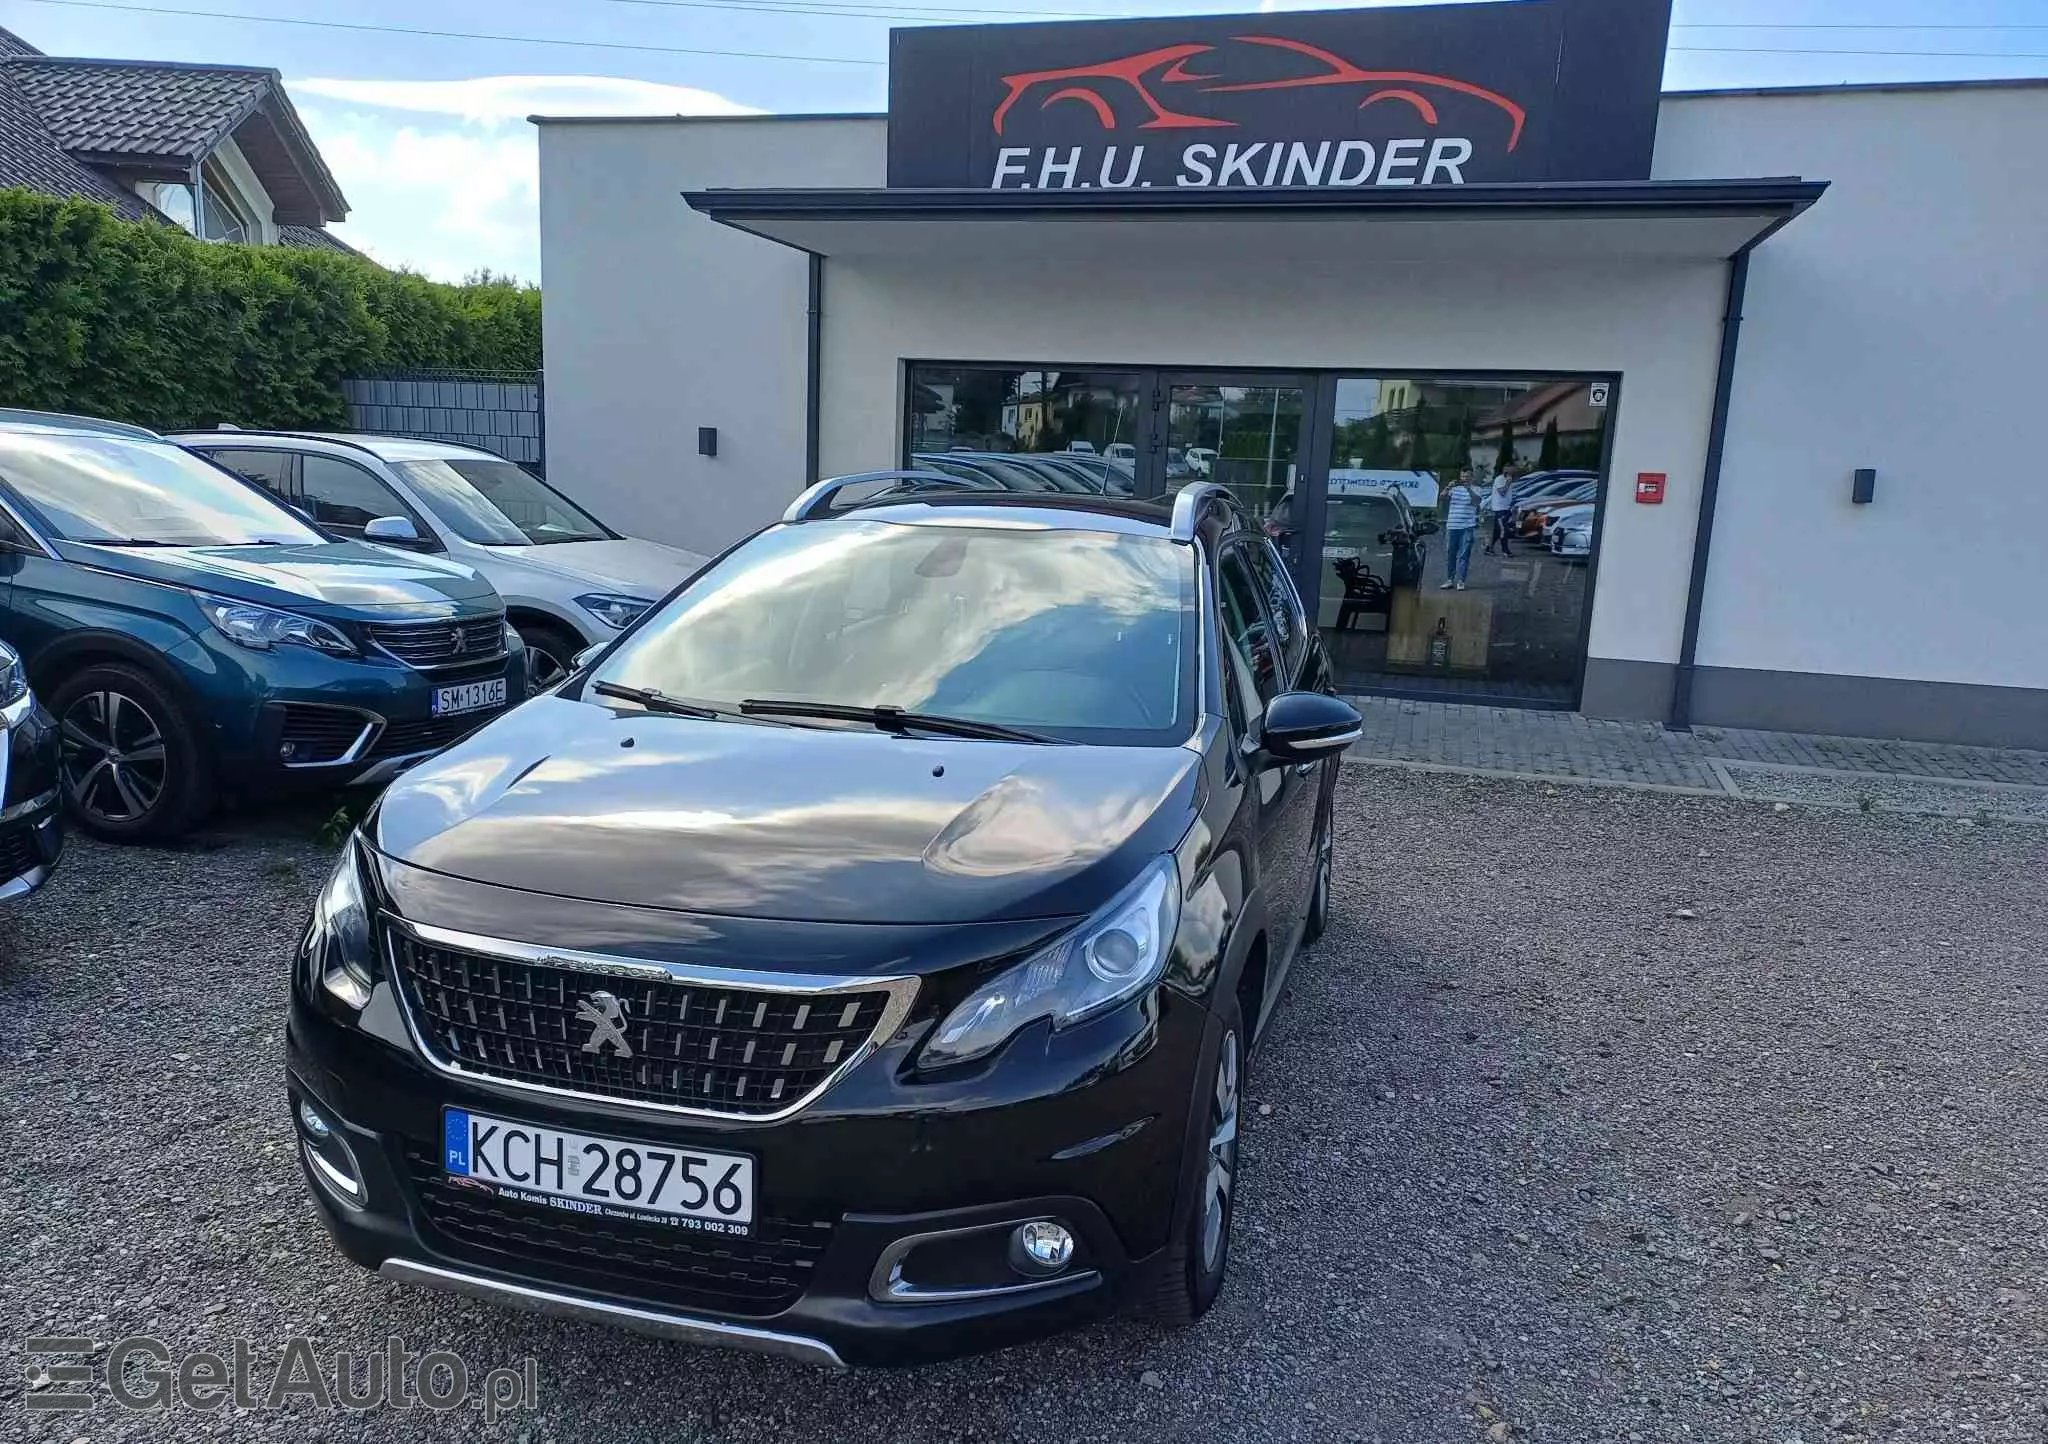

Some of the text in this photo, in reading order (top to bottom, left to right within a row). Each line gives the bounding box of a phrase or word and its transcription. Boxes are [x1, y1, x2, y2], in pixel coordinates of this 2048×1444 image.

[991, 137, 1474, 189] F.H.U. SKINDER
[465, 680, 504, 707] 1316E
[449, 1149, 466, 1167] PL
[471, 1121, 742, 1215] KCH 28756
[498, 1187, 519, 1199] Auto
[520, 1191, 548, 1206] Komis
[549, 1196, 603, 1216] SKINDER
[681, 1218, 702, 1230] 793
[704, 1221, 725, 1234] 002
[727, 1224, 749, 1237] 309
